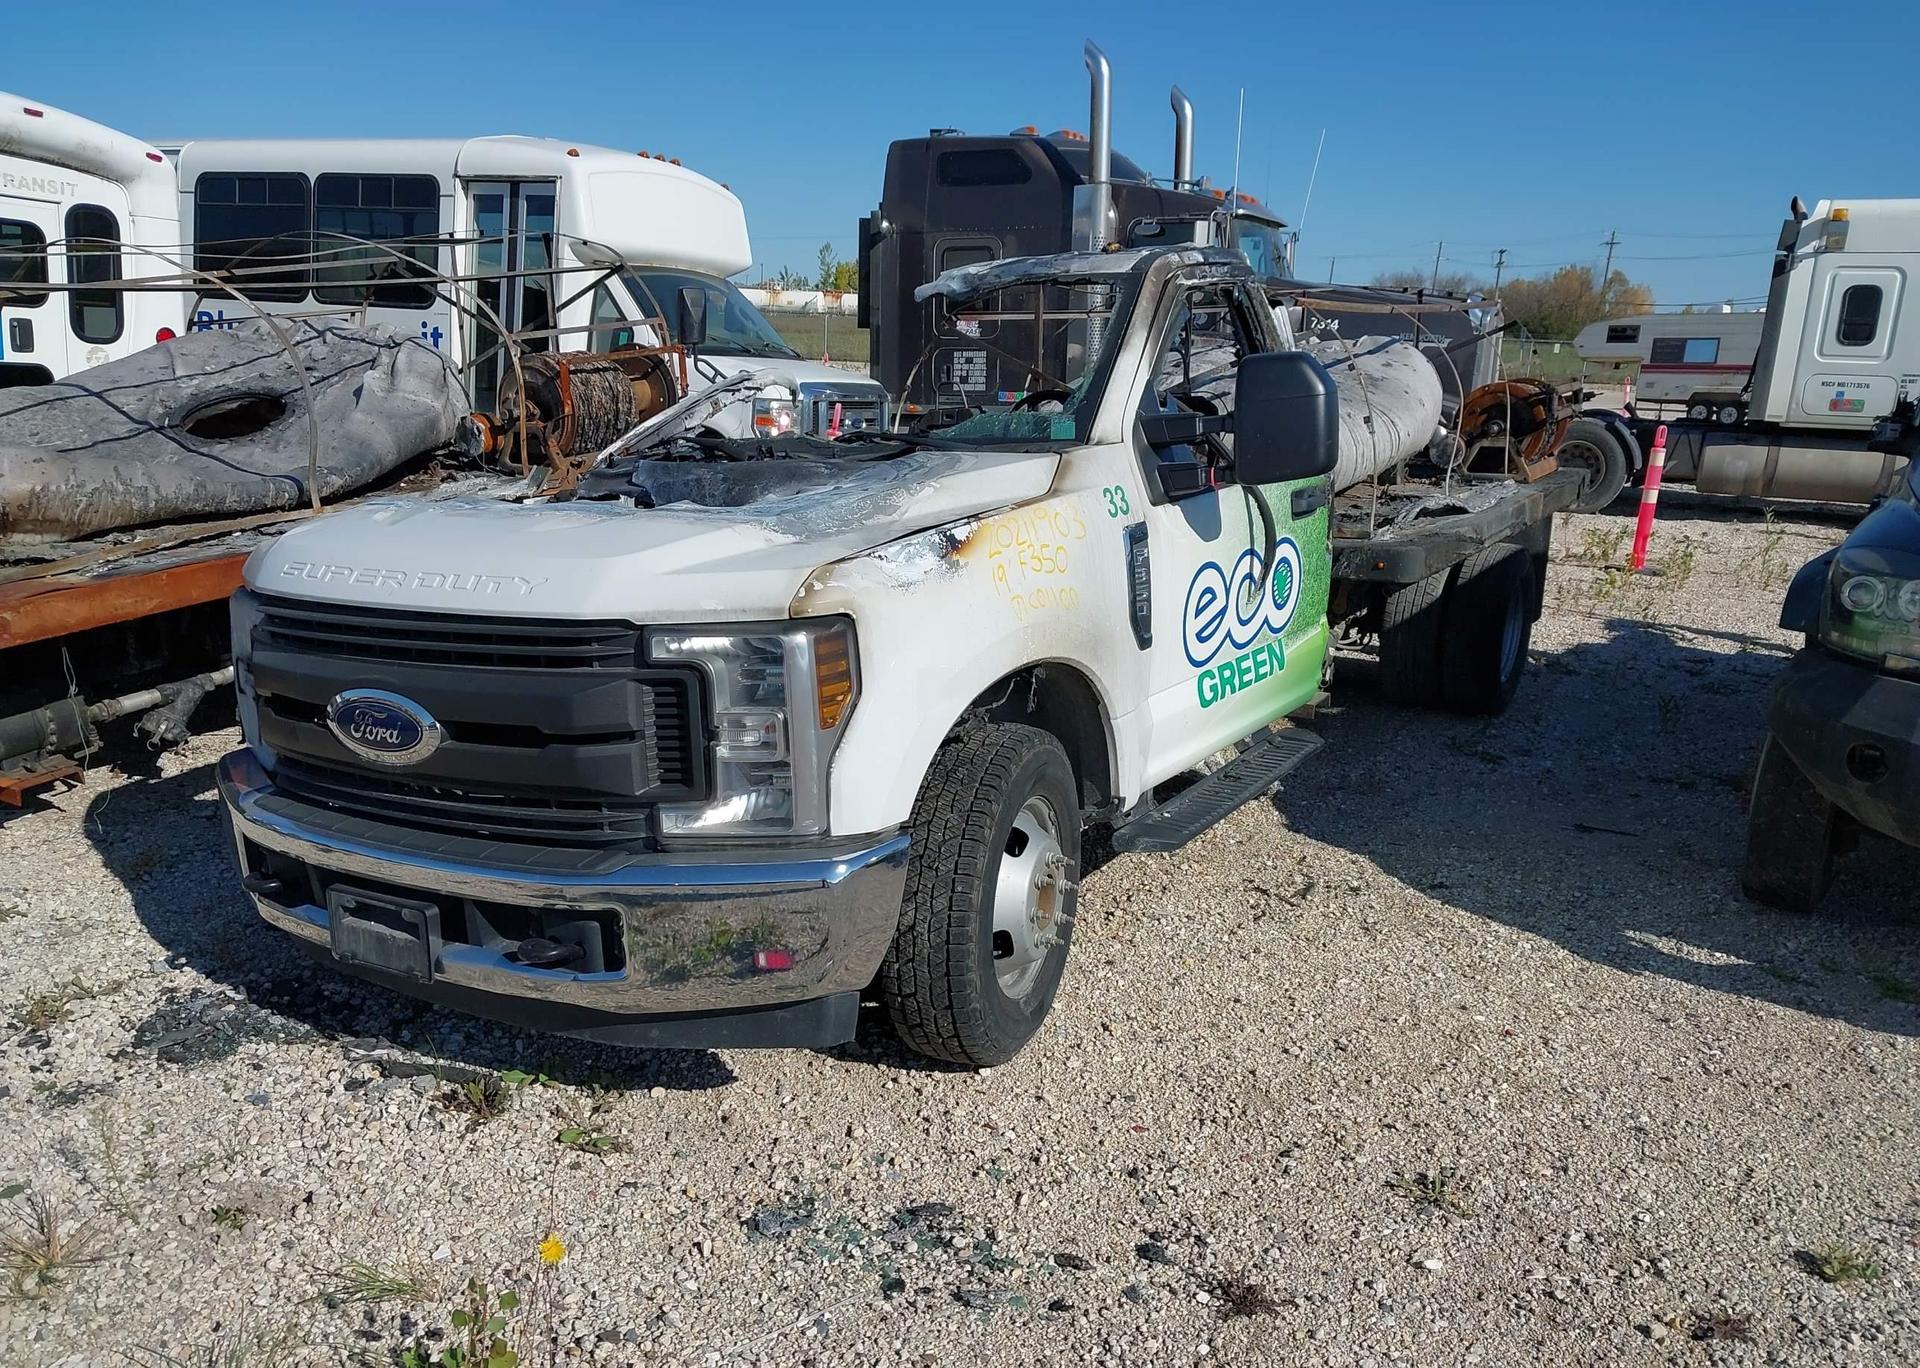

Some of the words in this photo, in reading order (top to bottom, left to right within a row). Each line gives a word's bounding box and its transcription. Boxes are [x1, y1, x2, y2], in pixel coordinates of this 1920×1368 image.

[0, 172, 78, 197] RANSIT
[1102, 485, 1130, 518] 33
[280, 561, 408, 588] SUPER
[411, 571, 549, 595] DUTY
[1017, 543, 1068, 580] F350
[1183, 536, 1302, 669] eco
[1197, 639, 1286, 709] GREEN
[350, 708, 402, 744] Ford
